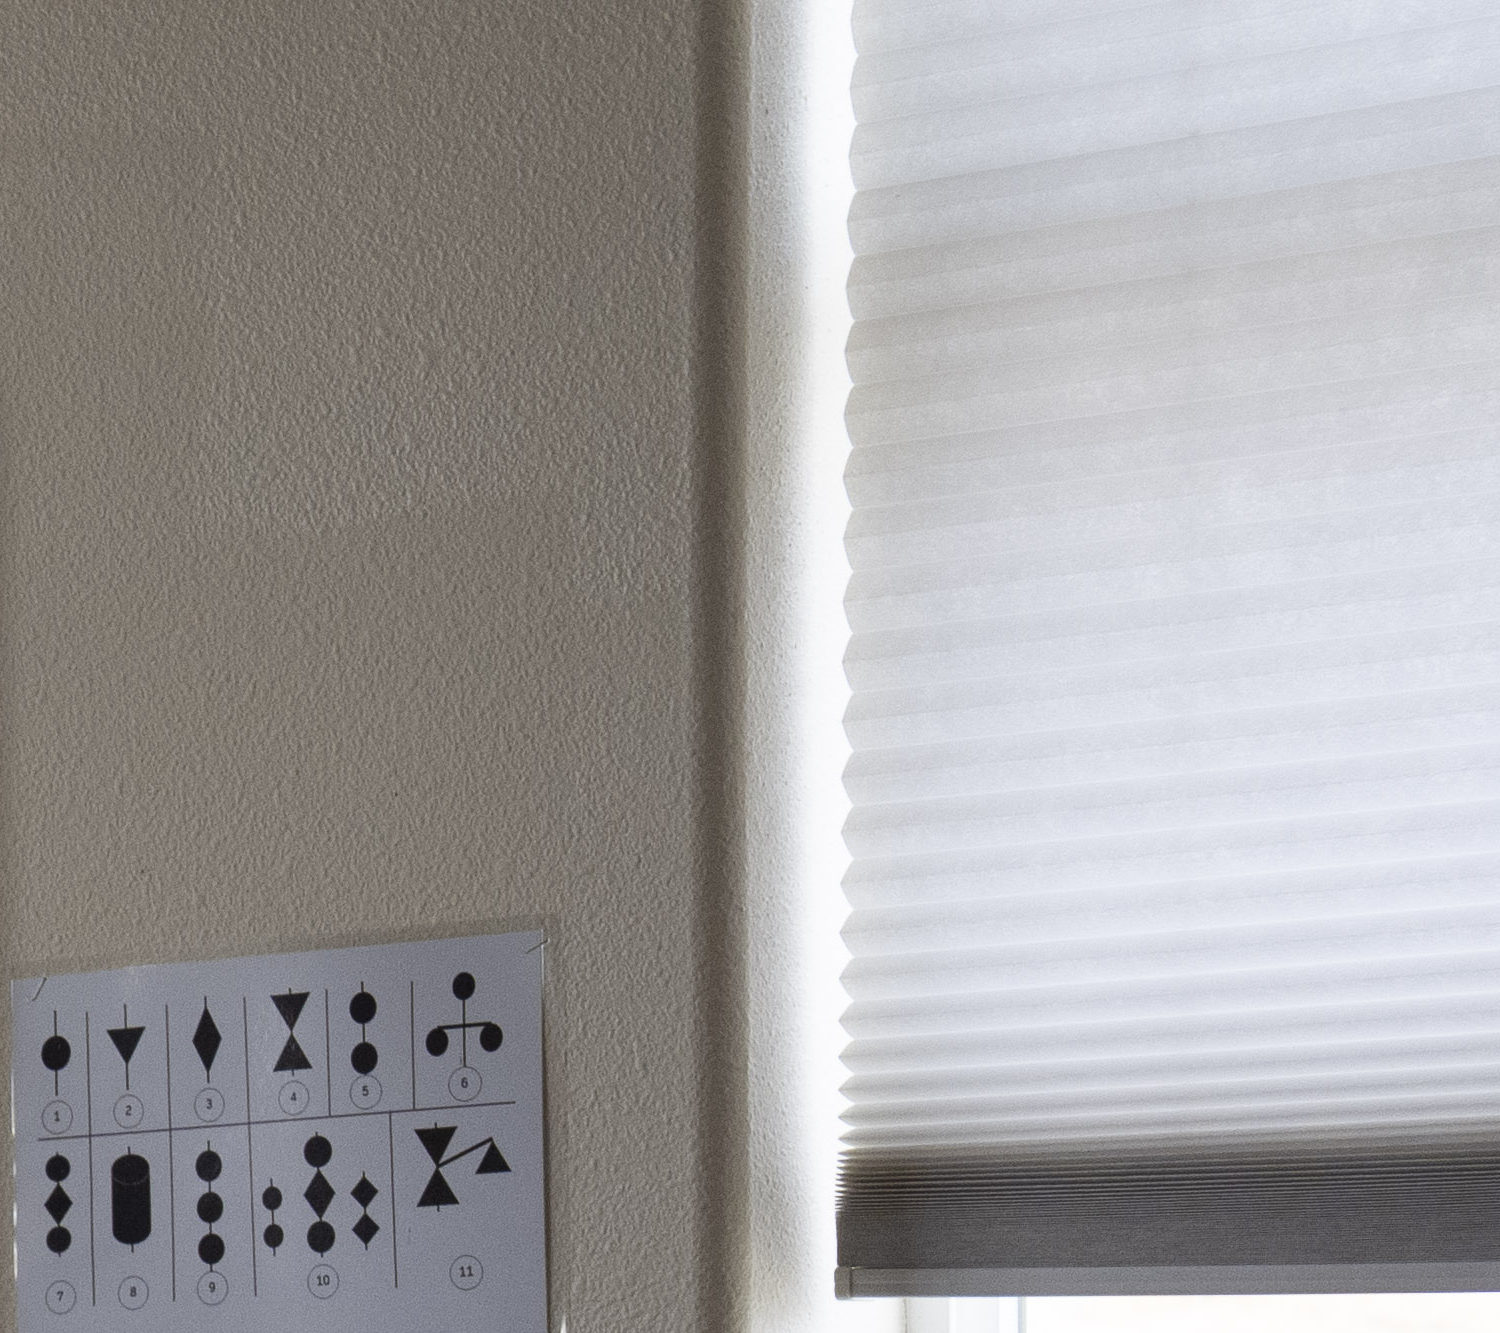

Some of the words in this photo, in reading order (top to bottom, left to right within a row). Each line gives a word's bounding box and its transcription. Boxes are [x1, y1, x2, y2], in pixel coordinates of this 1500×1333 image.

[54, 1111, 60, 1122] 1
[125, 1105, 132, 1116] 2
[206, 1099, 213, 1110] 3
[289, 1092, 297, 1102] 4
[362, 1086, 369, 1097] 5
[461, 1077, 468, 1088] 6
[57, 1291, 64, 1302] 7
[130, 1286, 137, 1297] 8
[209, 1282, 216, 1293] 9
[317, 1275, 331, 1287] 10
[459, 1266, 474, 1277] 11
